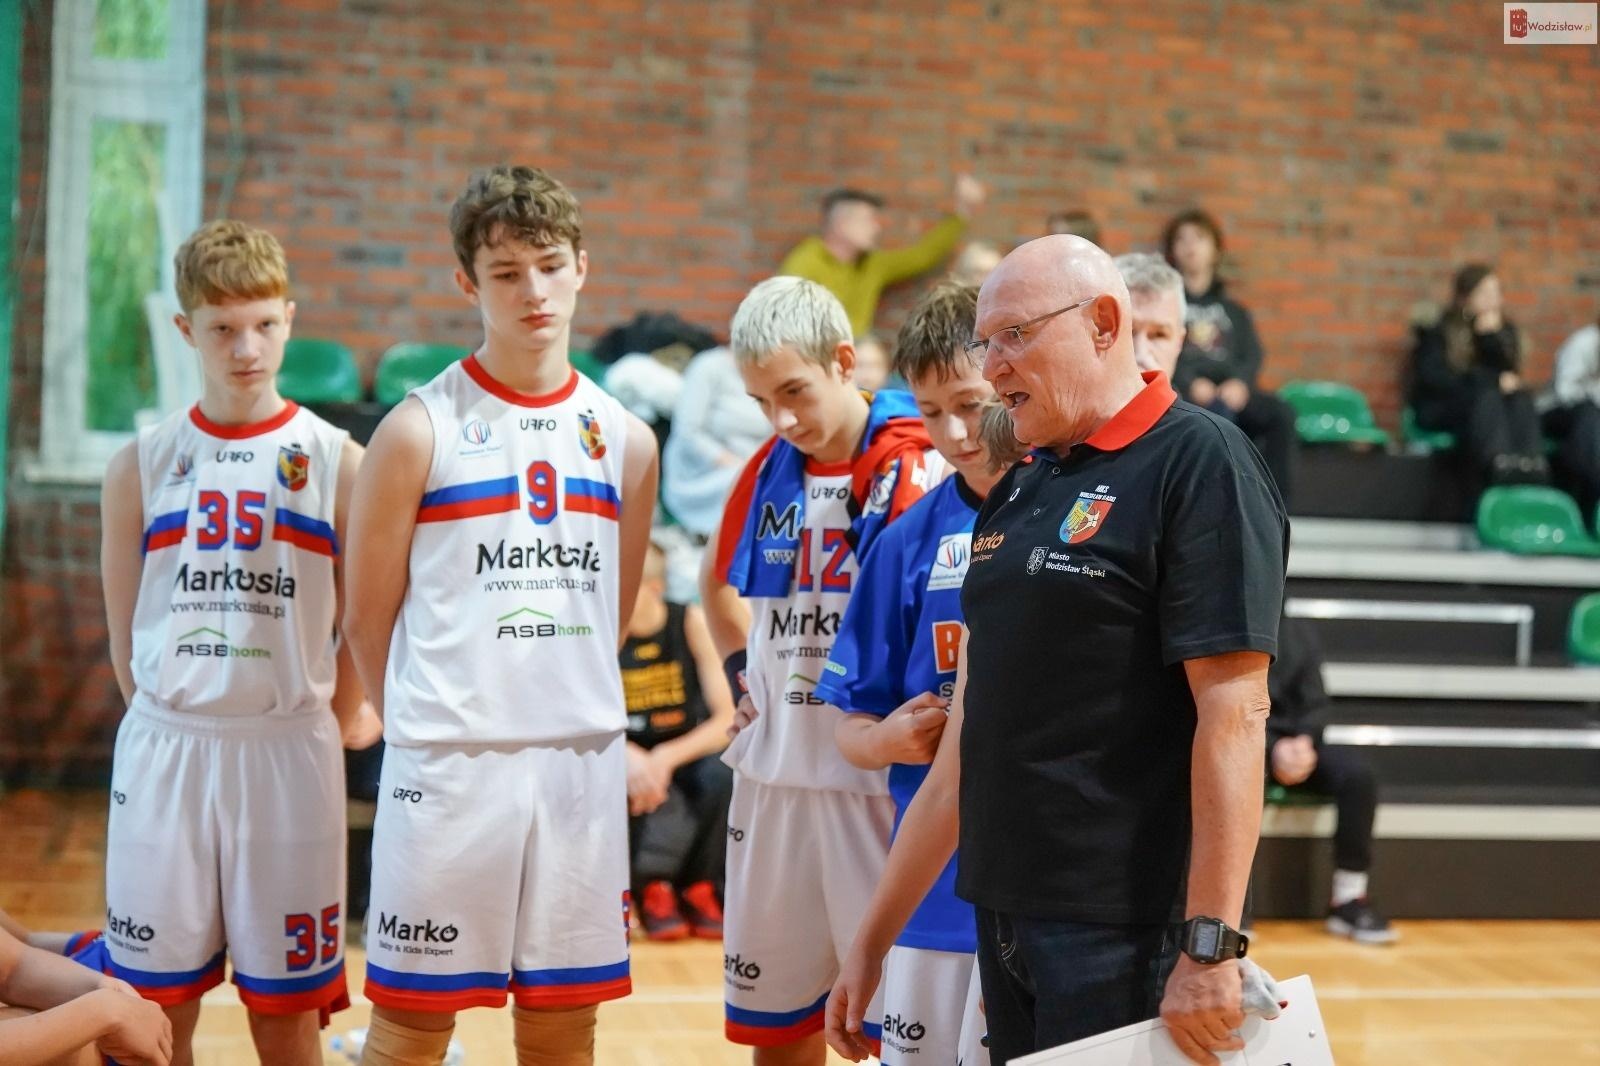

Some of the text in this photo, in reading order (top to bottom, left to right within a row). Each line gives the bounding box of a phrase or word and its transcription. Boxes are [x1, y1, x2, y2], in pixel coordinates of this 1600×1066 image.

[526, 460, 558, 525] 9
[196, 489, 266, 551] 35
[972, 531, 1005, 553] arko
[1048, 551, 1070, 562] Miasto
[798, 528, 851, 593] 12
[1045, 561, 1081, 573] Wodzisław
[107, 908, 155, 942] arko
[284, 902, 340, 973] 35
[377, 911, 459, 943] Marko
[883, 1013, 926, 1041] arko
